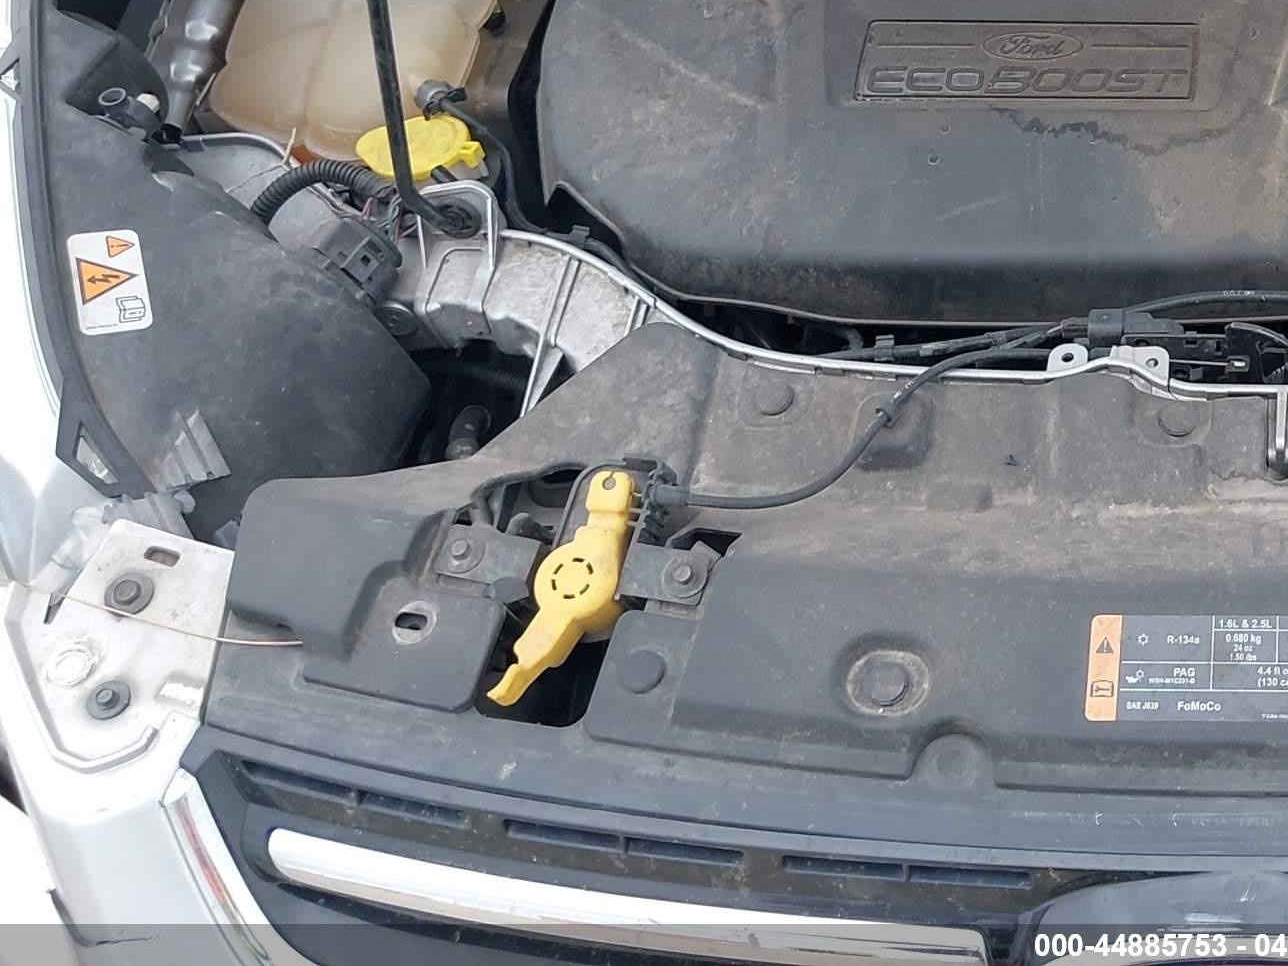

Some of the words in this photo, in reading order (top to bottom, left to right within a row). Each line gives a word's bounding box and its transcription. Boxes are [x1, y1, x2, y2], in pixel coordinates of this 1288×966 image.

[1000, 35, 1064, 58] Ford
[866, 66, 1189, 94] ECOBOOST
[1219, 619, 1239, 628] 1.6L
[1242, 619, 1249, 628] &
[1251, 619, 1272, 628] 2.5L
[1167, 635, 1200, 644] R-134a
[1225, 633, 1248, 643] 0.680
[1250, 633, 1262, 645] kg
[1233, 644, 1243, 652] 24
[1173, 667, 1195, 677] PAG
[1257, 666, 1272, 674] 4.4
[1274, 666, 1281, 674] fl
[1257, 677, 1278, 688] (130
[1126, 701, 1141, 710] SAE
[1177, 701, 1221, 711] FoMoCo
